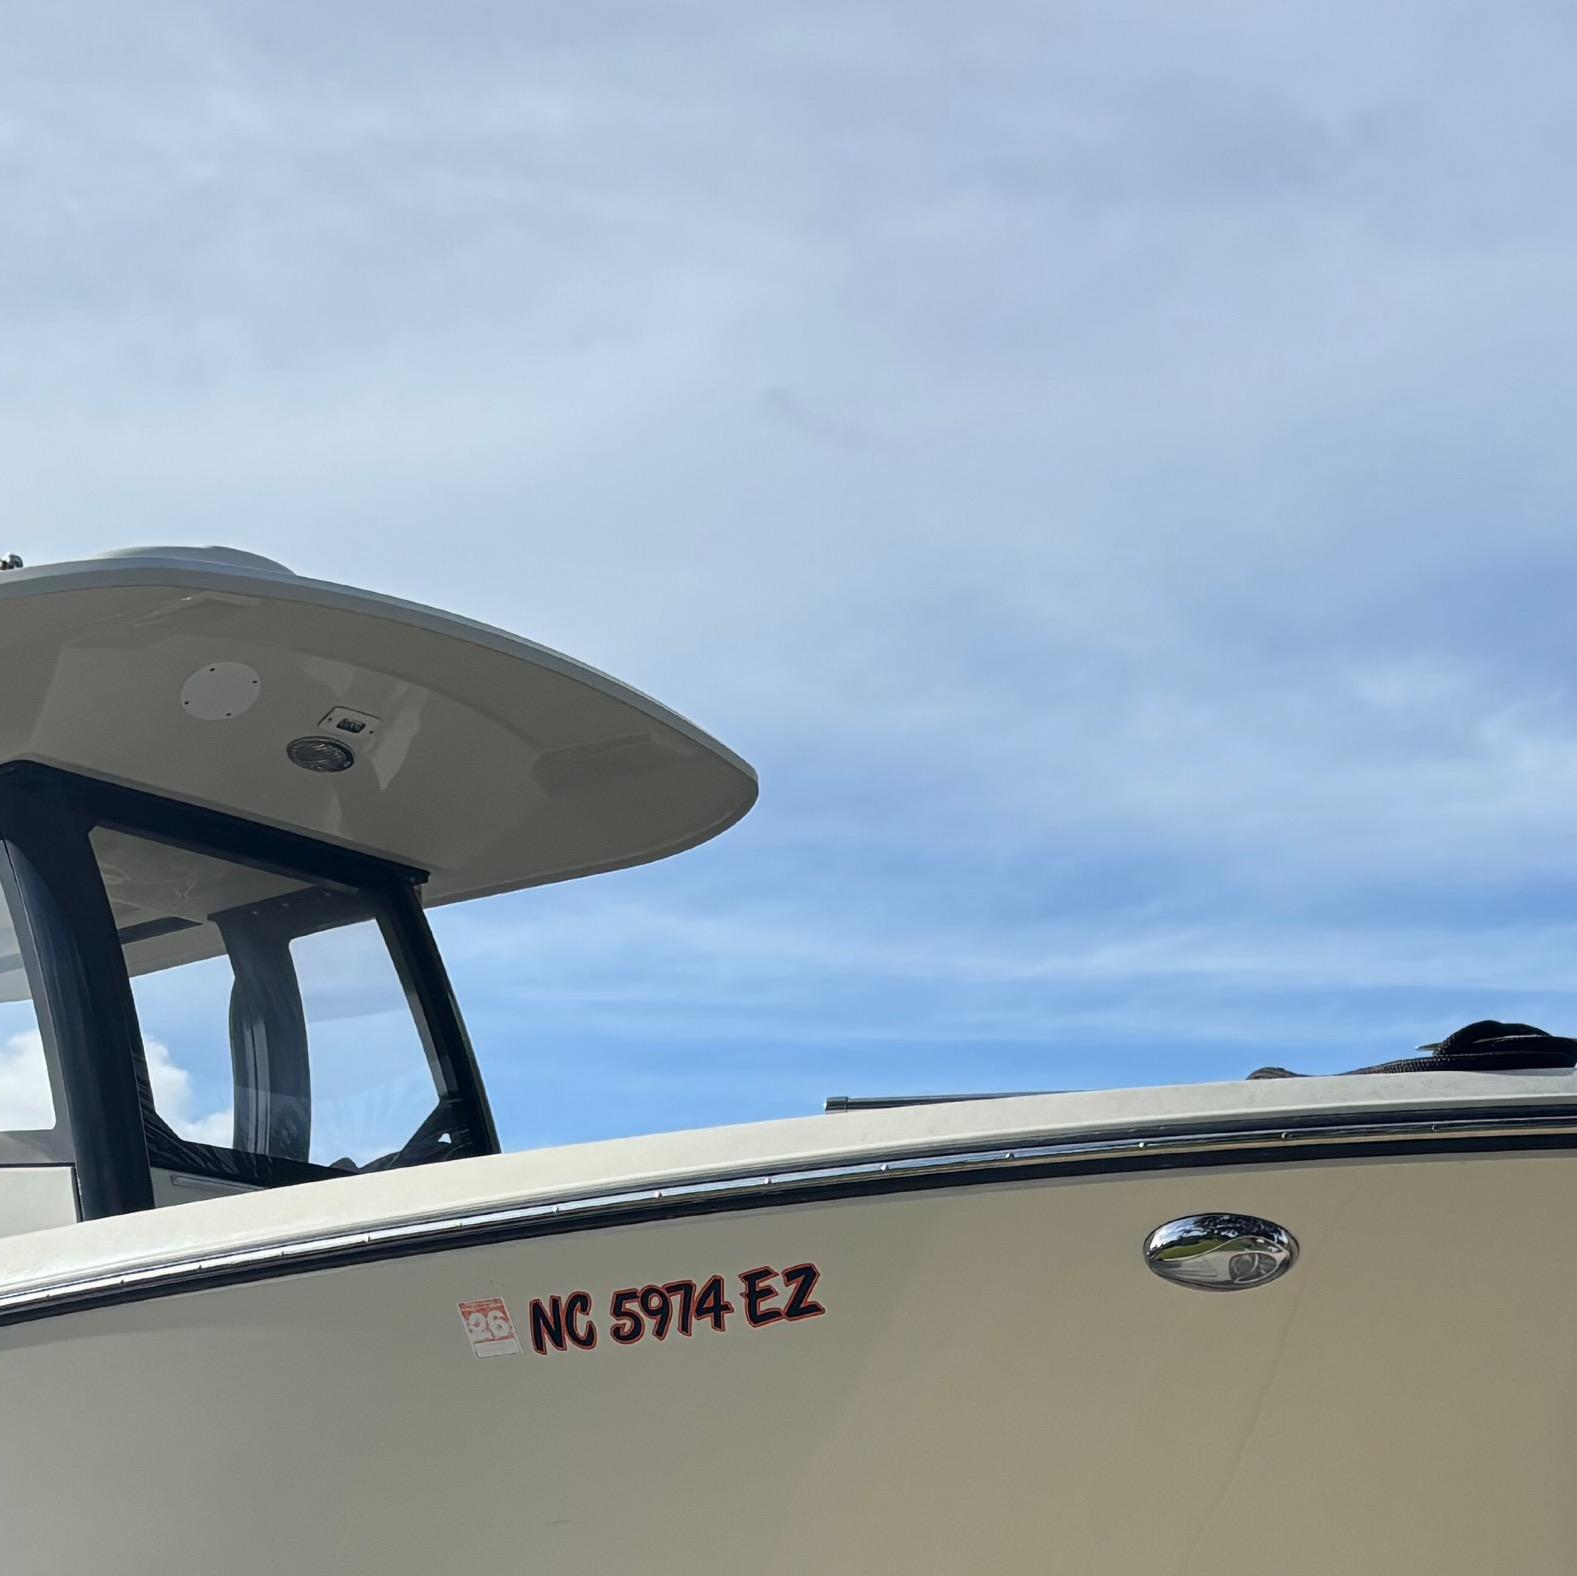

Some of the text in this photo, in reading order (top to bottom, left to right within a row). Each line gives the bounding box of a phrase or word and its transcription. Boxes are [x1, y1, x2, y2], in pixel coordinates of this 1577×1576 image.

[528, 1262, 826, 1356] NC 5974 EZ
